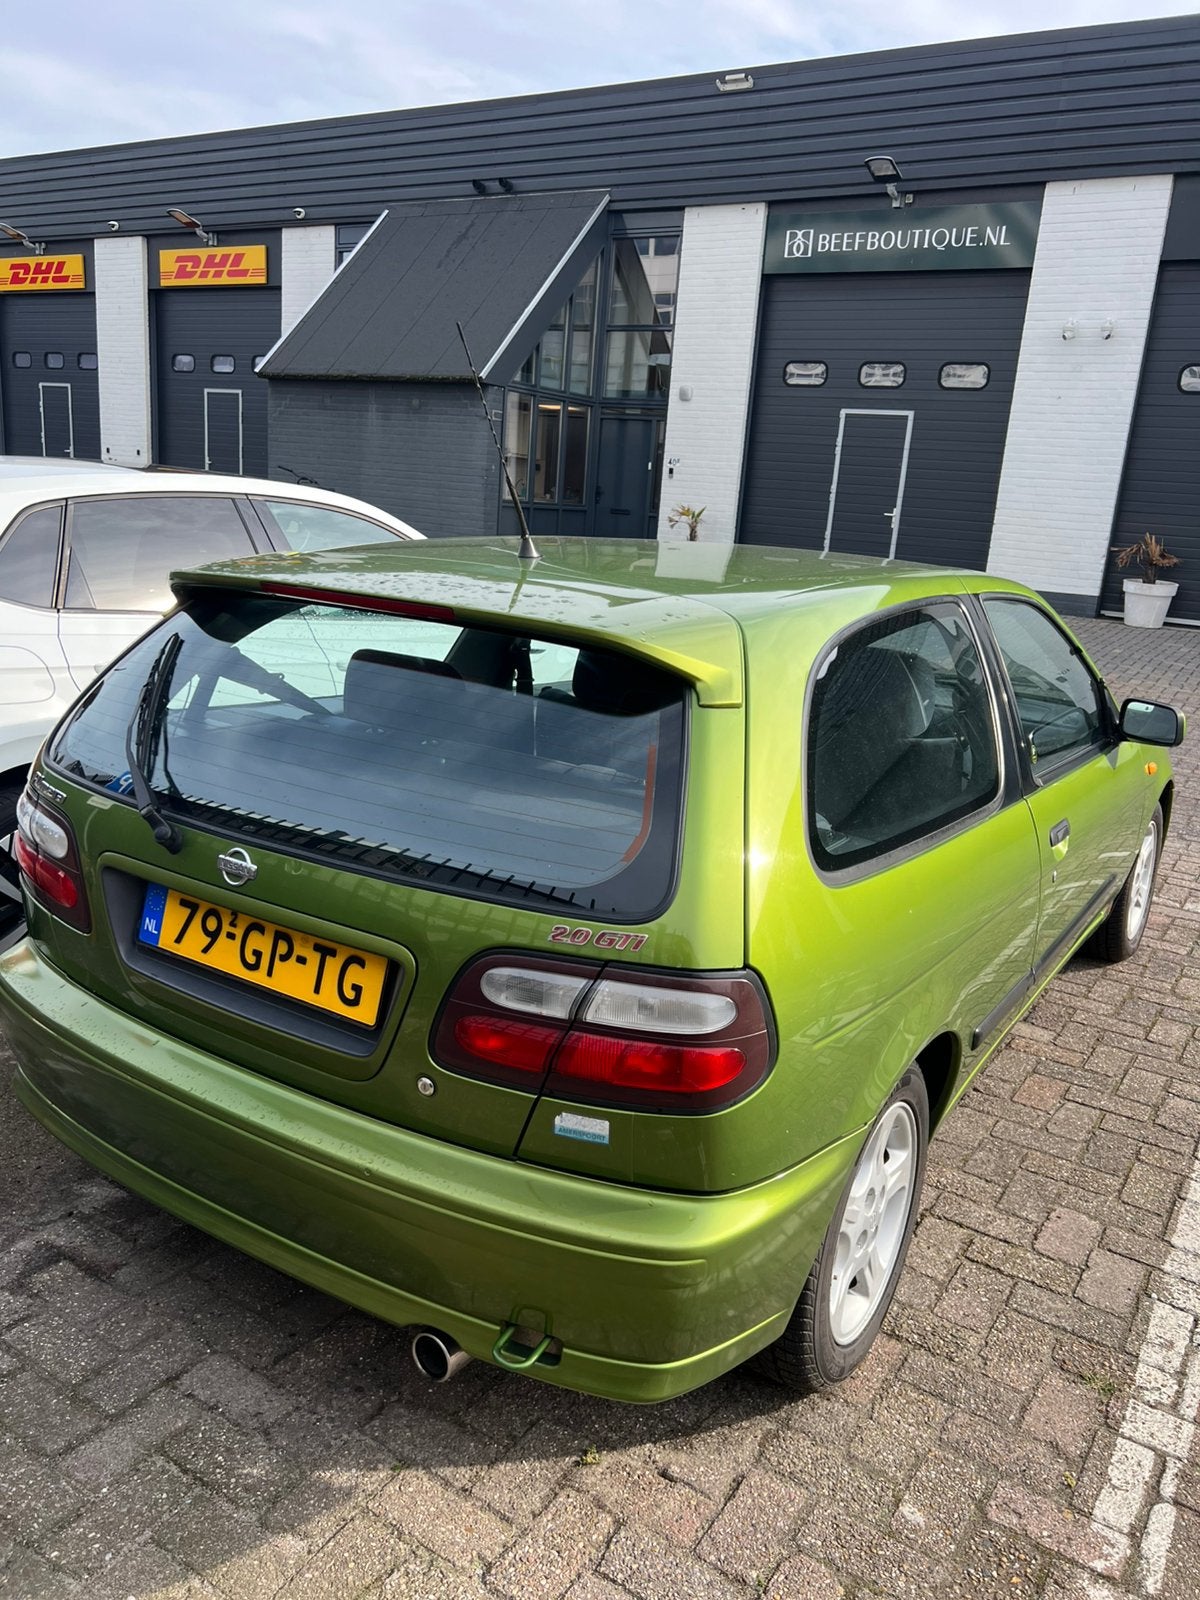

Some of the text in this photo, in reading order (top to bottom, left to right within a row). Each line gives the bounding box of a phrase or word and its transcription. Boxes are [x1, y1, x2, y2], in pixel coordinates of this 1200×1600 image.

[817, 225, 1012, 252] BEEFBOUTIQUE.NL
[9, 260, 71, 285] DHL
[174, 252, 251, 279] DHL
[144, 917, 159, 935] NL
